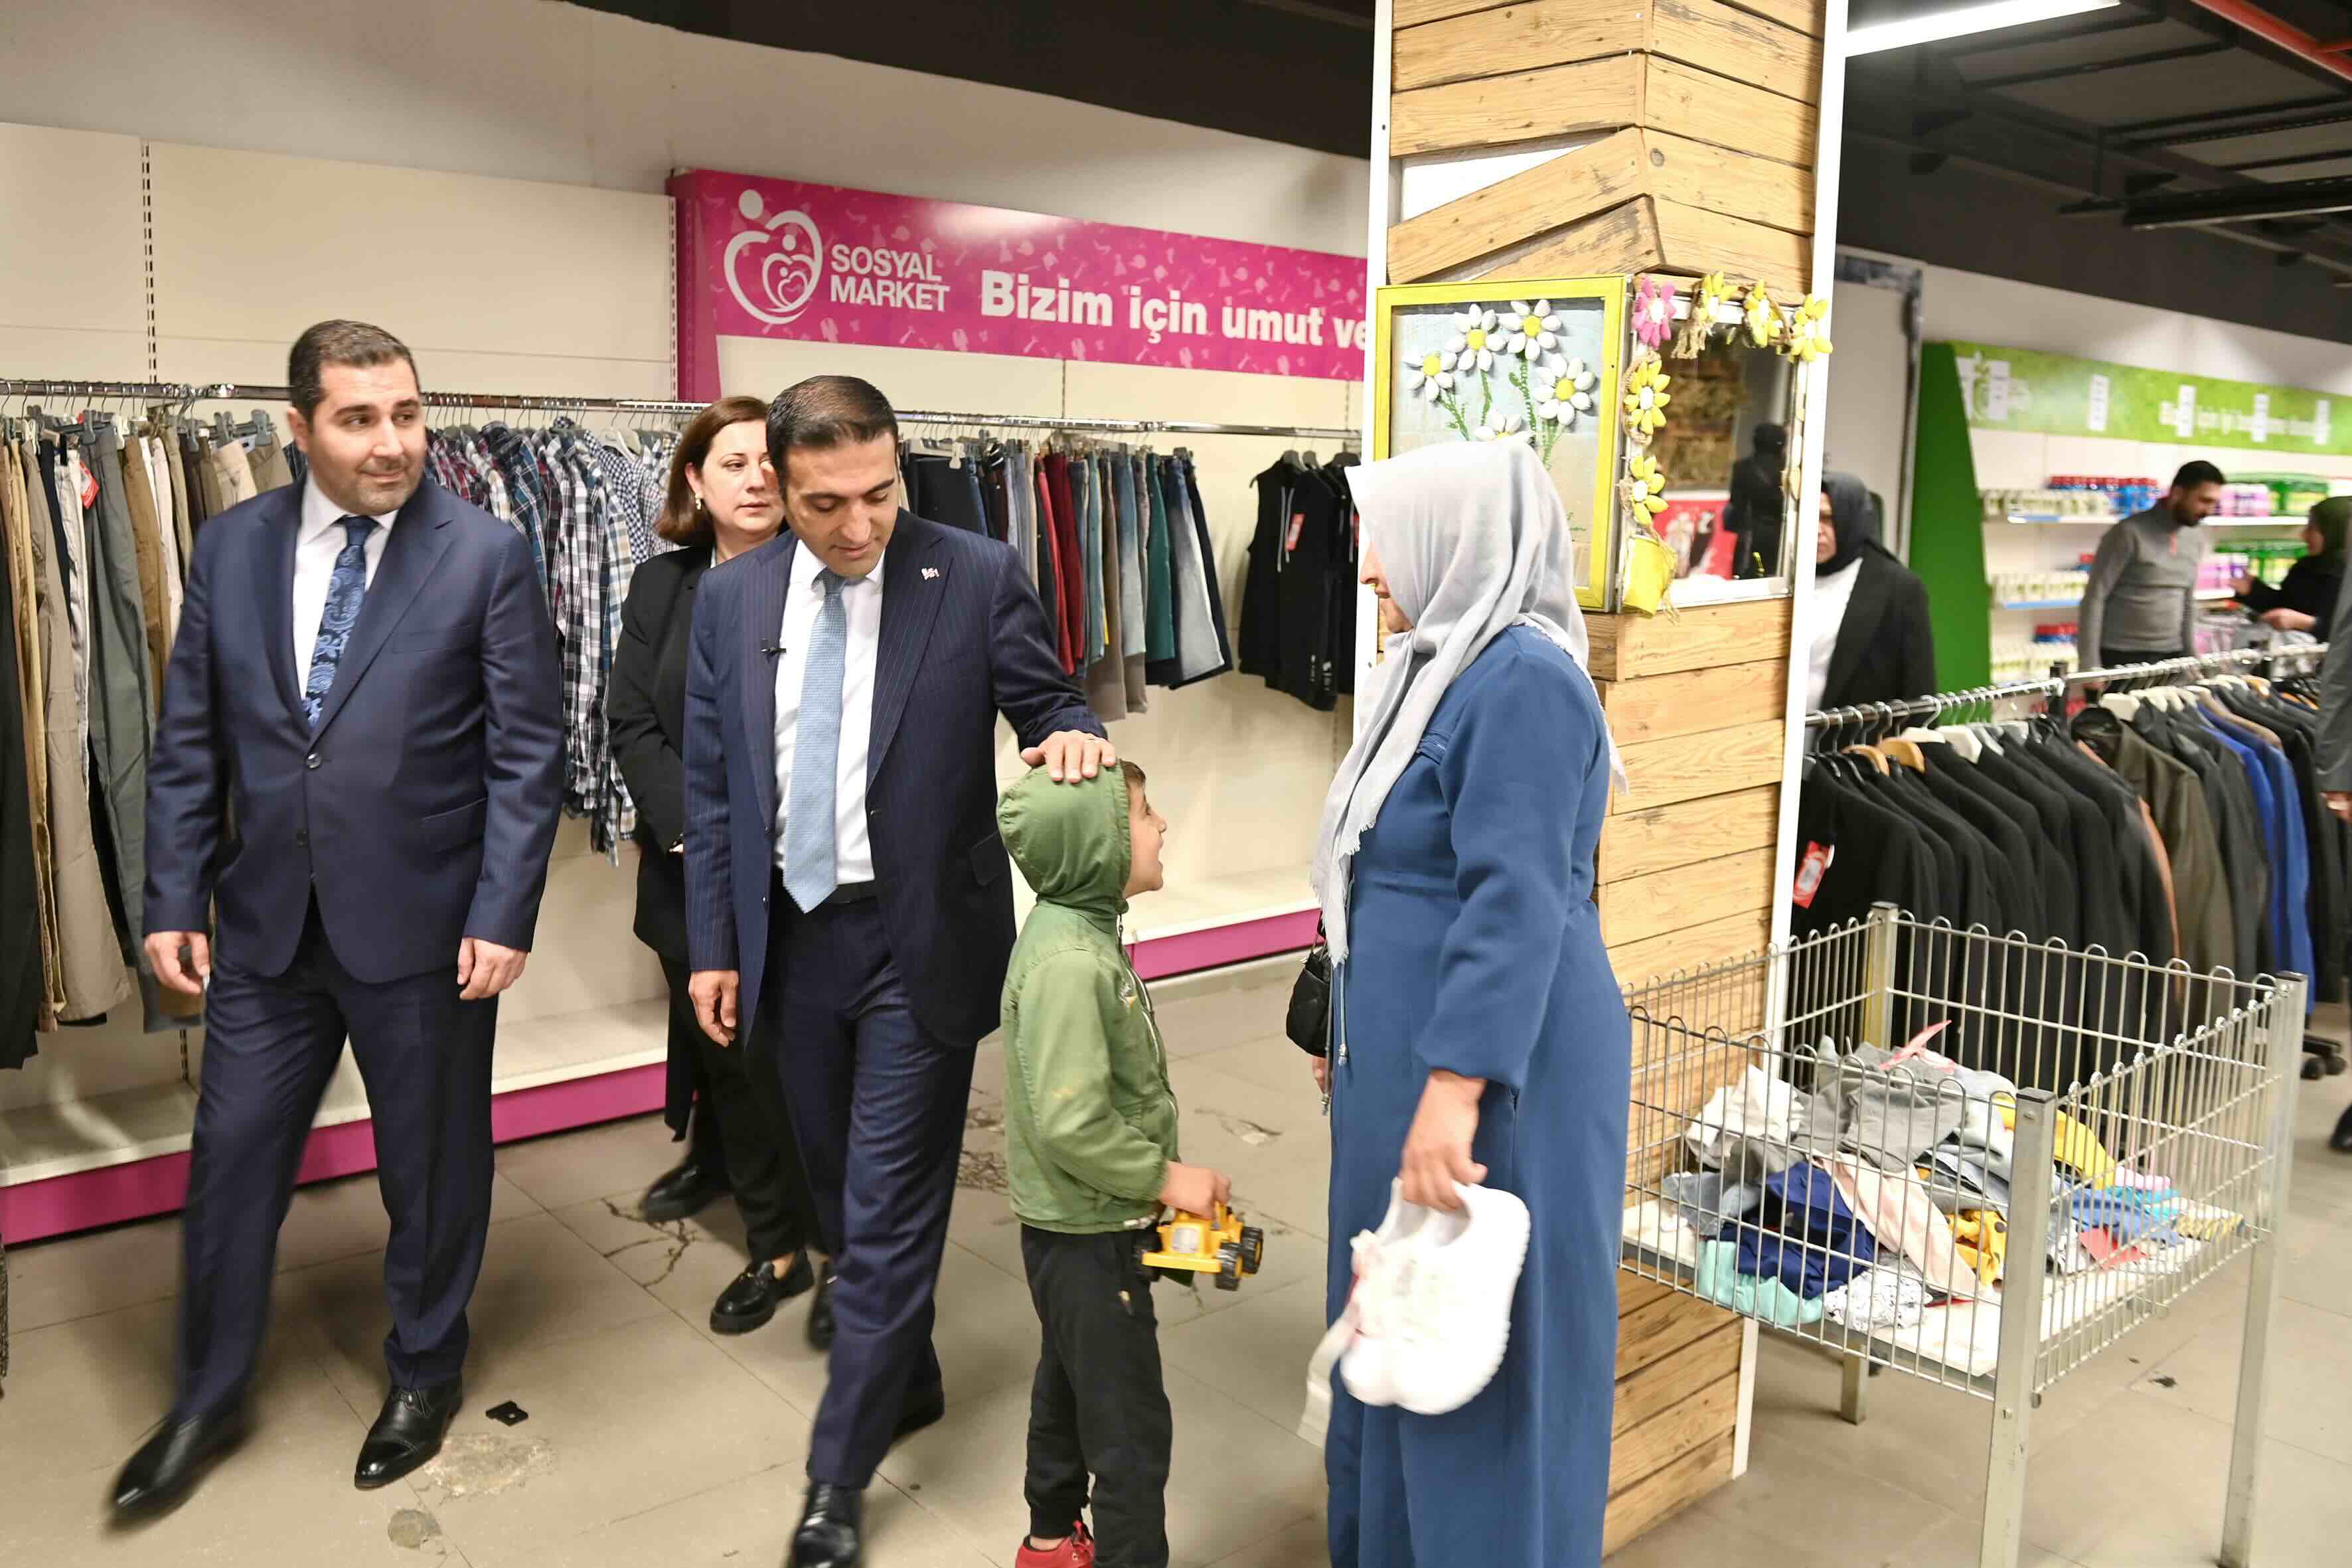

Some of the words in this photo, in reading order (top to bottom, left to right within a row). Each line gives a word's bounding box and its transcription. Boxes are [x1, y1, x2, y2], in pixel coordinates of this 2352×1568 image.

[830, 244, 942, 282] SOSYAL
[830, 274, 951, 312] MARKET
[981, 270, 1113, 327] Bizim
[1129, 285, 1208, 344] için
[1222, 305, 1324, 346] umut
